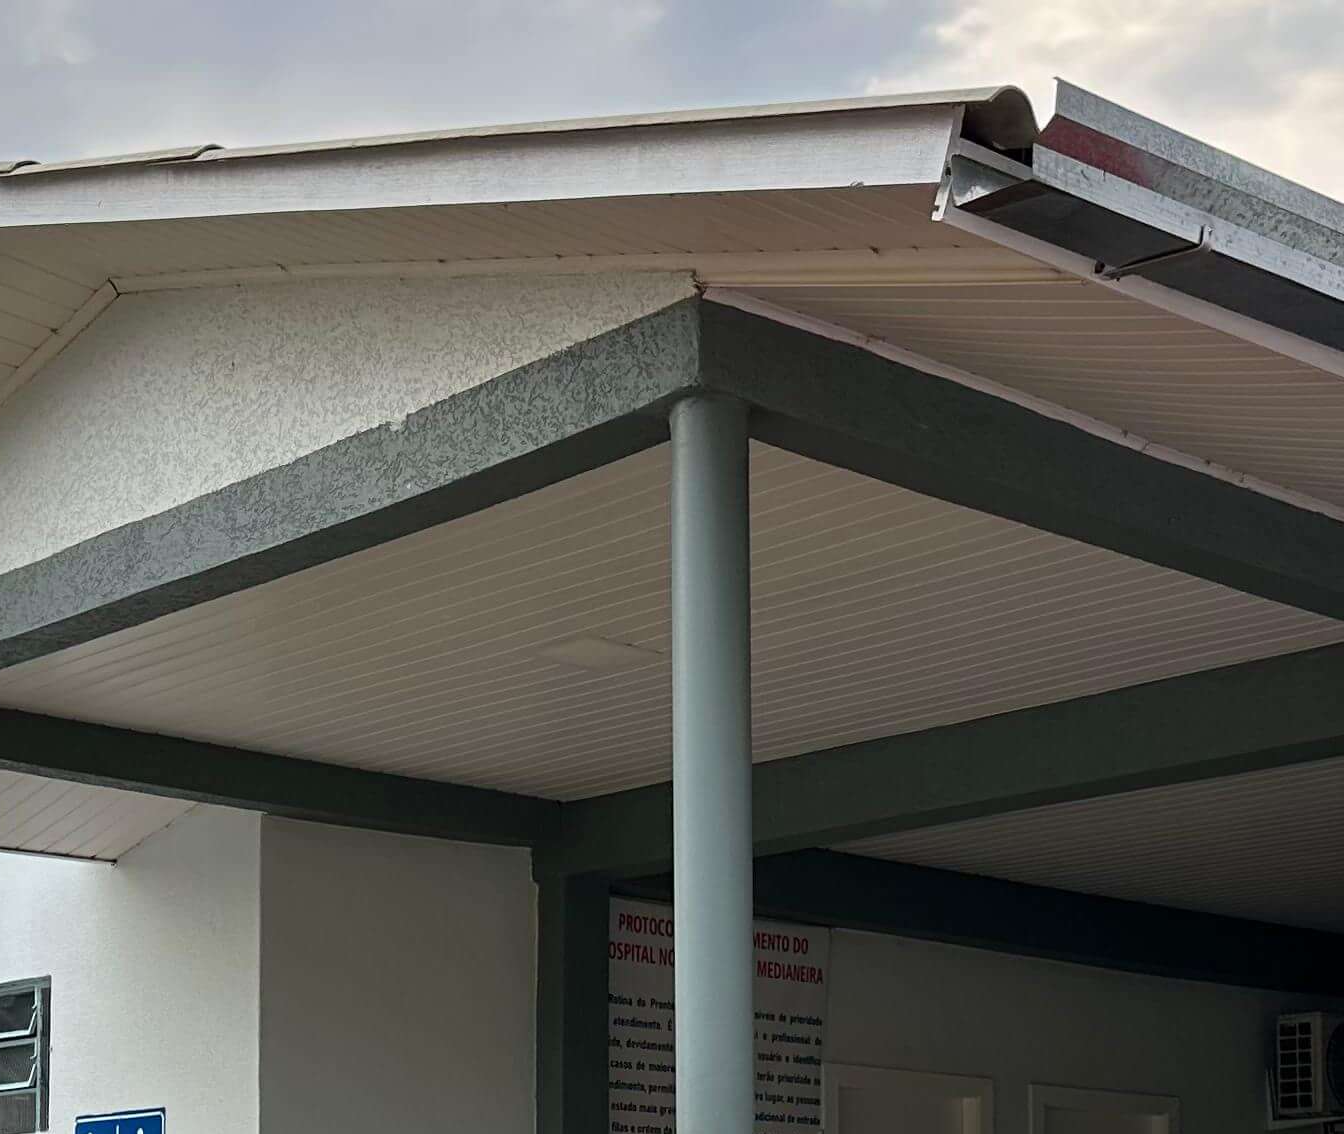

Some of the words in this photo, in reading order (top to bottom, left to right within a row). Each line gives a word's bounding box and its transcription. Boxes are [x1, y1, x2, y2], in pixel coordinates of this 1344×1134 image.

[618, 913, 674, 938] PROTOCO
[793, 936, 808, 955] DO
[608, 942, 656, 964] OSPITAL
[757, 960, 824, 984] MEDIANEIRA
